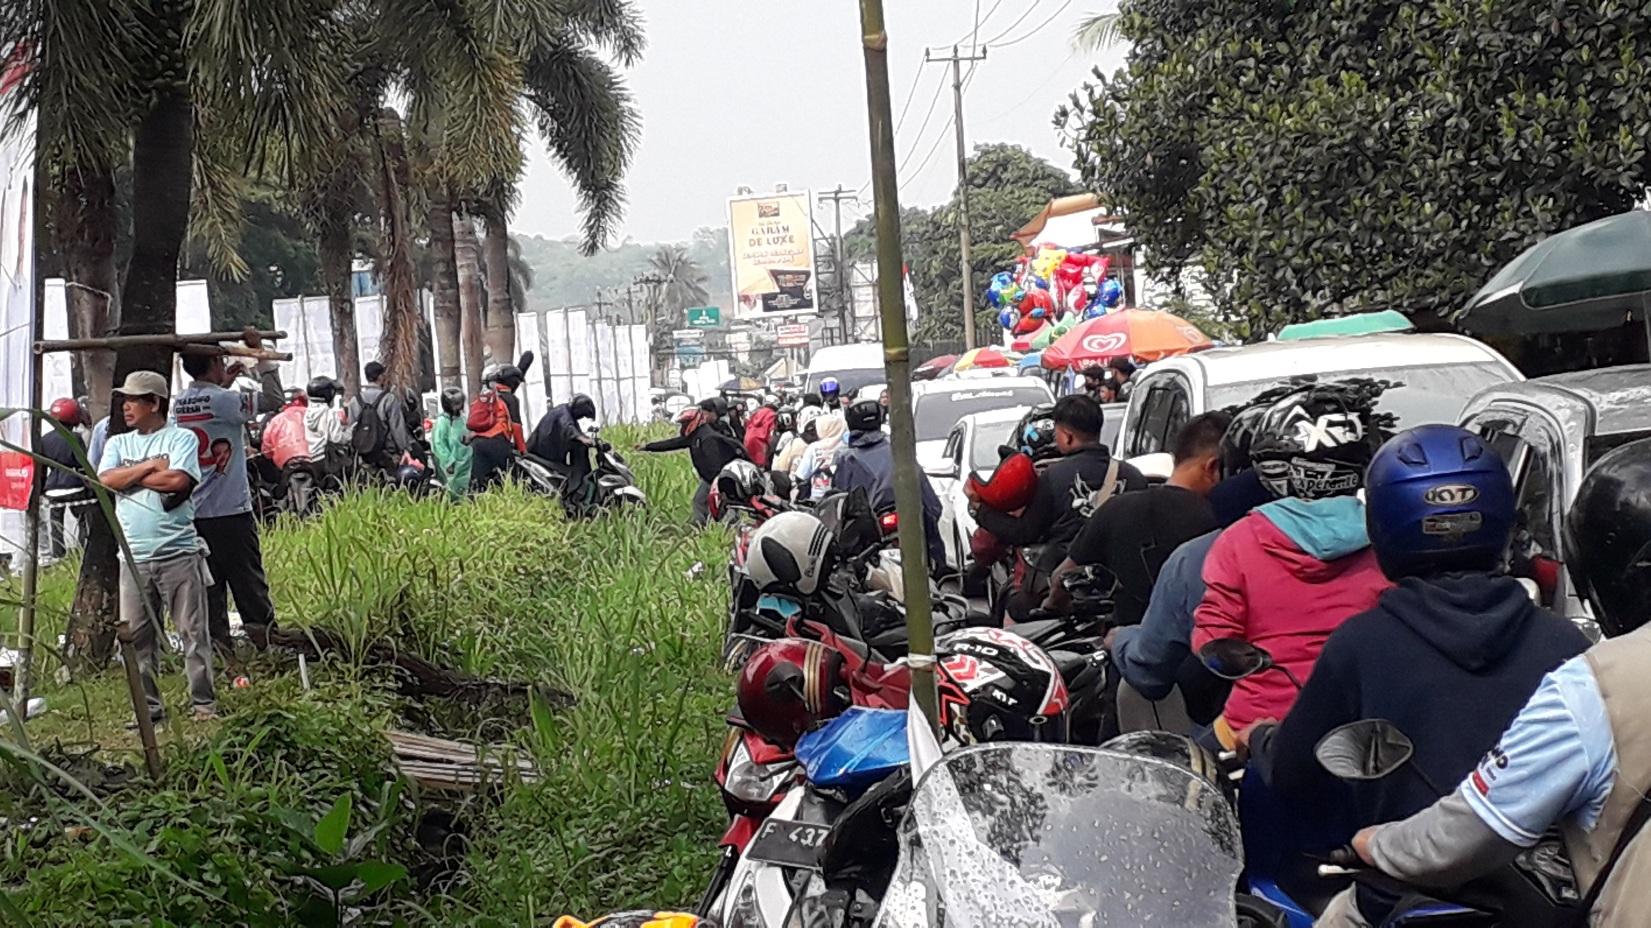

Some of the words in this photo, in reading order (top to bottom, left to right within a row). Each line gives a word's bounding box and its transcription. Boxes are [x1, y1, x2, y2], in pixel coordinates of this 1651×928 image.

[749, 237, 763, 248] DE
[766, 234, 796, 246] LUXE
[1425, 486, 1477, 502] KYT
[953, 642, 999, 656] R-10
[761, 822, 777, 839] F
